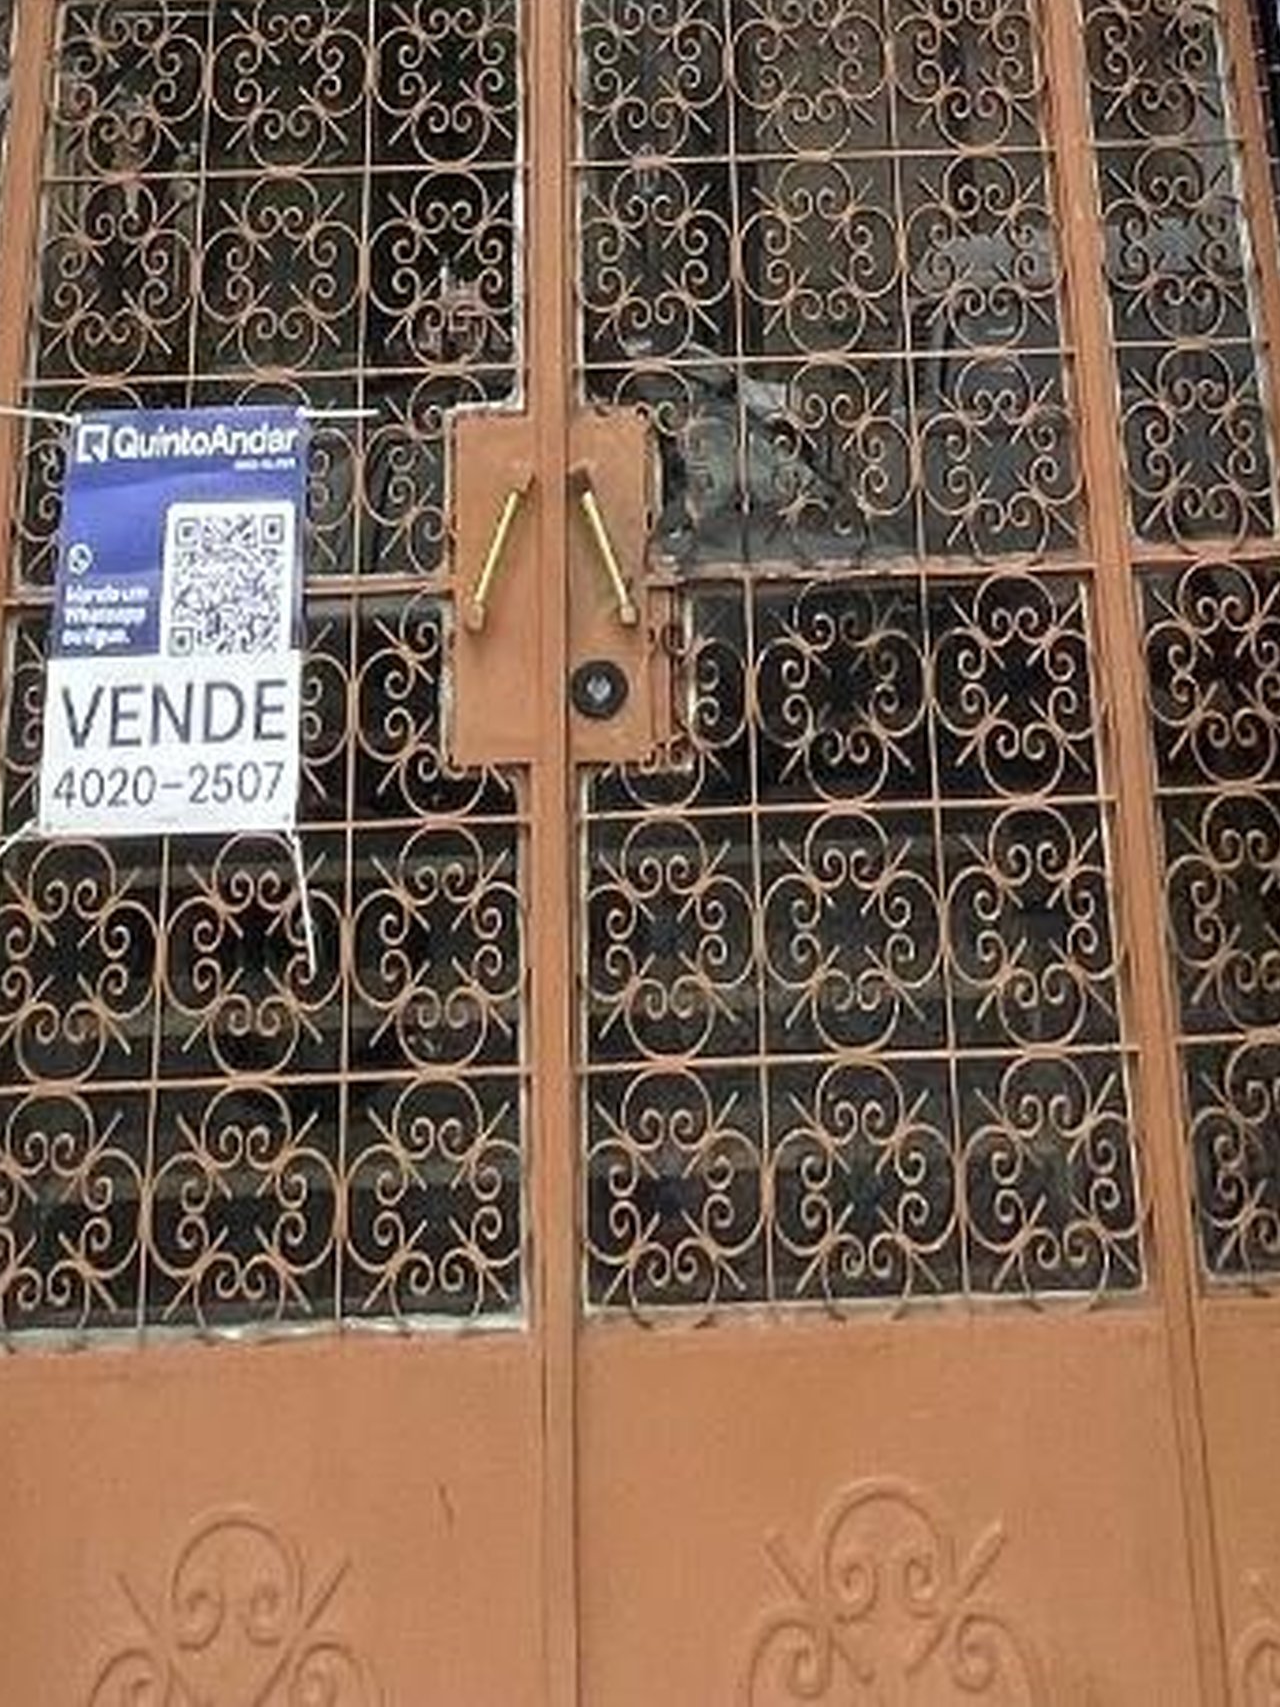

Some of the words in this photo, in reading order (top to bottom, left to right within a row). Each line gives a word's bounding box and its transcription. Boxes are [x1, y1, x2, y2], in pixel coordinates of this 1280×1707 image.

[113, 424, 299, 459] QuintoAndar
[62, 680, 288, 748] VENDE
[53, 761, 284, 809] 4020-2507
